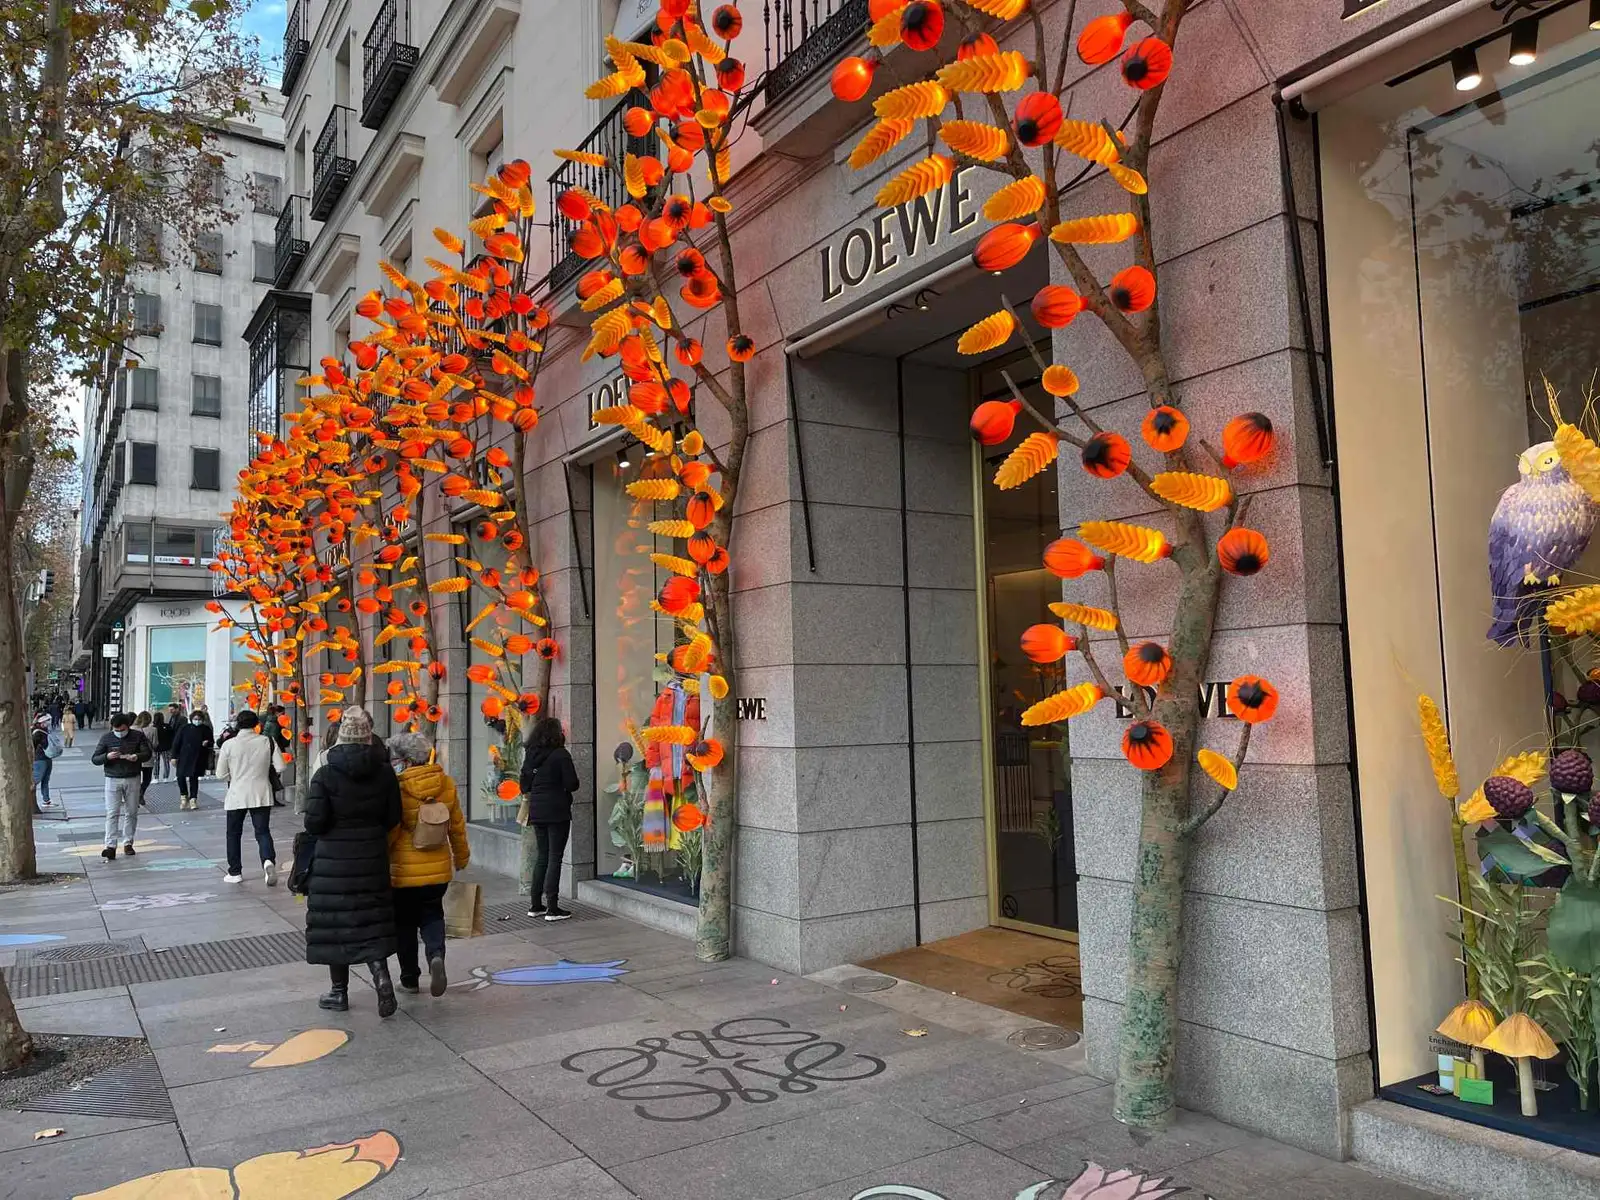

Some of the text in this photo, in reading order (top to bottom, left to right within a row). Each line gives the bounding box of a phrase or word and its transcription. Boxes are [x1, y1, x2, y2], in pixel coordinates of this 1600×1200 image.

[821, 165, 978, 302] LOEWE
[587, 374, 632, 432] LOE
[160, 607, 191, 618] IQOS
[735, 697, 767, 720] EWE
